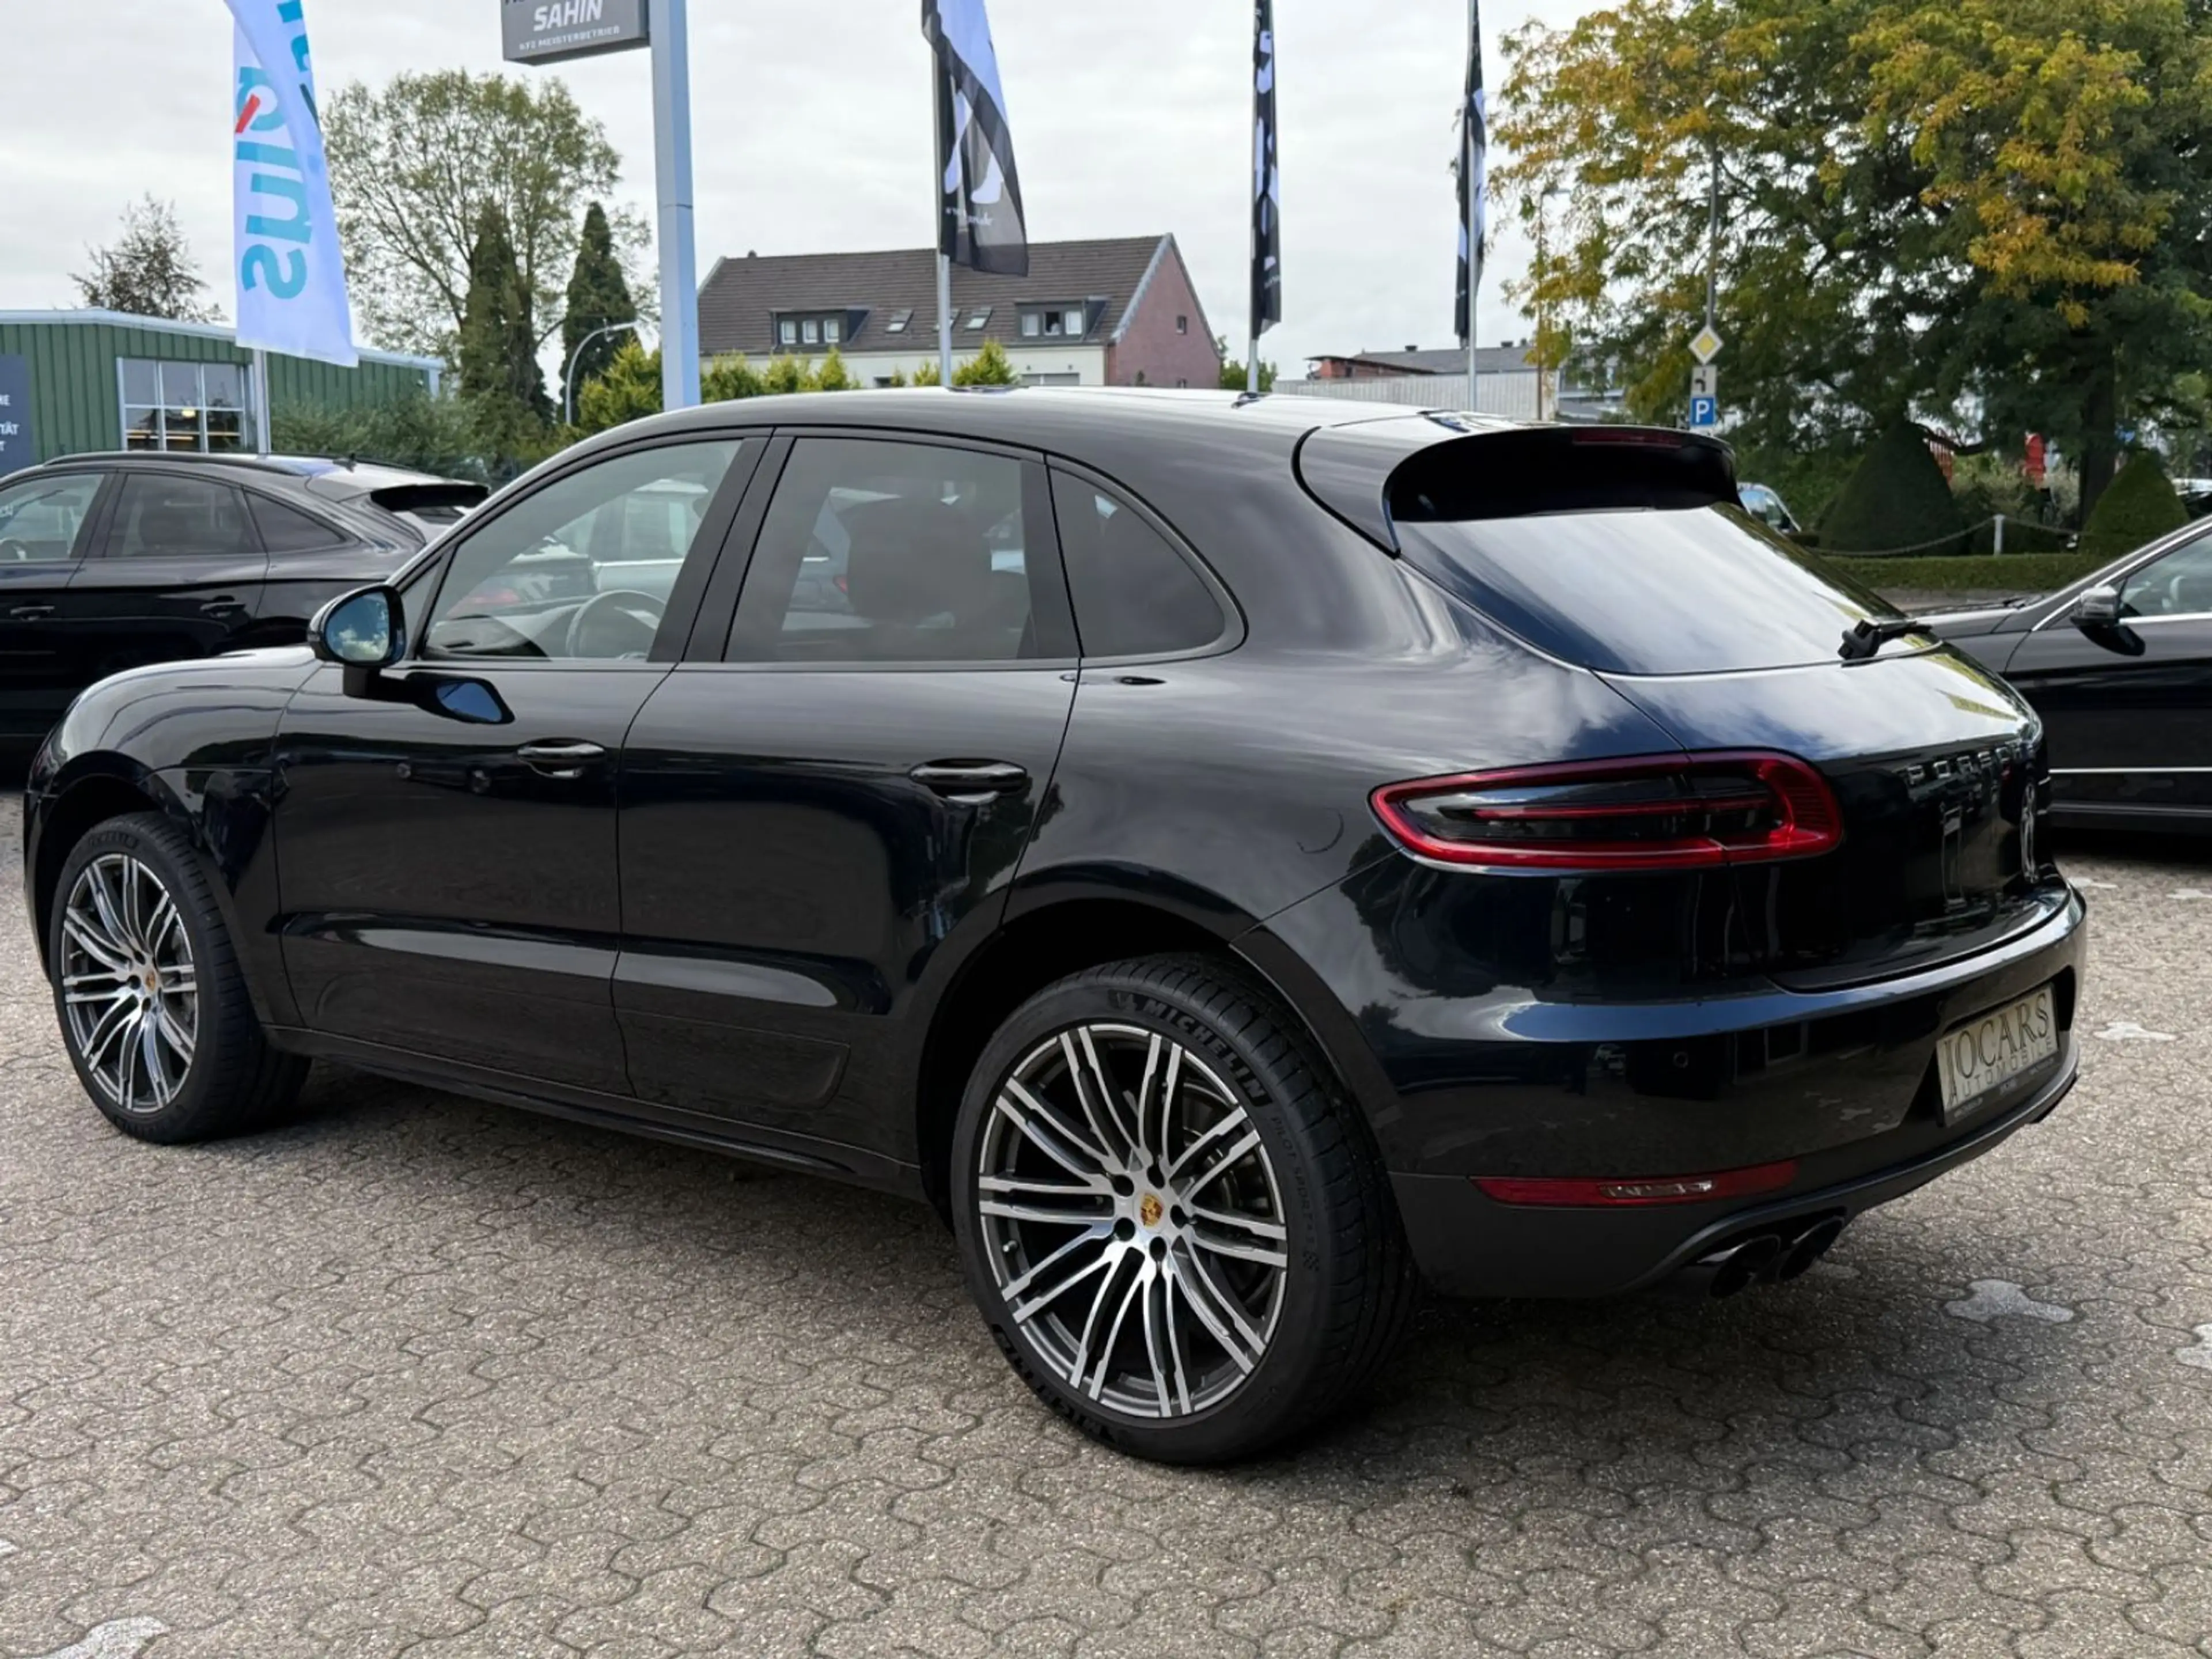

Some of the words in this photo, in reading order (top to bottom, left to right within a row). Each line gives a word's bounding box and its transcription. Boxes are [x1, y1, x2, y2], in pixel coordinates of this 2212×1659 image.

[533, 0, 604, 31] SAHIN
[1695, 400, 1710, 423] P
[1143, 1000, 1268, 1099] MICHELIN
[1944, 993, 2050, 1091] JOCARS
[1946, 1035, 2053, 1107] AUTOMOBILE
